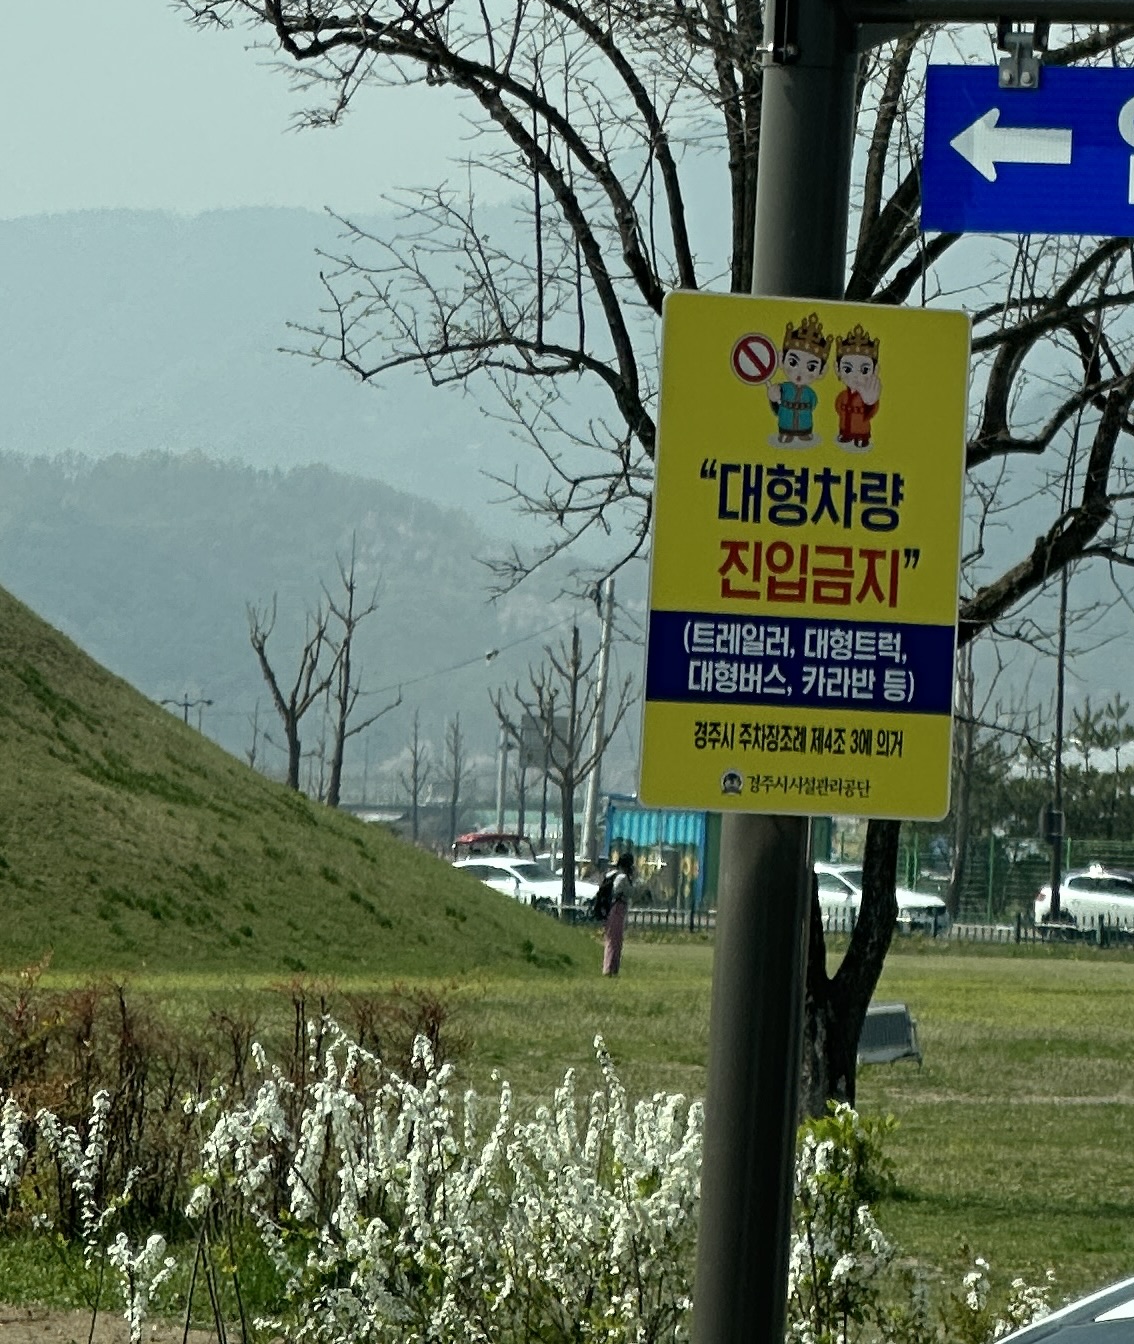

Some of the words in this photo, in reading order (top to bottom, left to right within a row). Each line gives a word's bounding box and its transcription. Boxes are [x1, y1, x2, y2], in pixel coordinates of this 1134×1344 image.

[700, 459, 905, 532] “대형차량
[717, 540, 921, 608] 진입금지”
[683, 621, 795, 658] (트레일러,
[804, 626, 907, 664] 대형트럭,
[688, 660, 793, 697] 대형버스,
[802, 665, 877, 700] 카라반
[883, 668, 915, 703] 등)
[694, 721, 735, 751] 경주시
[739, 722, 807, 754] 주차장조례
[810, 726, 846, 755] 제4조
[876, 728, 904, 758] 의거
[747, 775, 872, 798] 경주시시설관리공단
